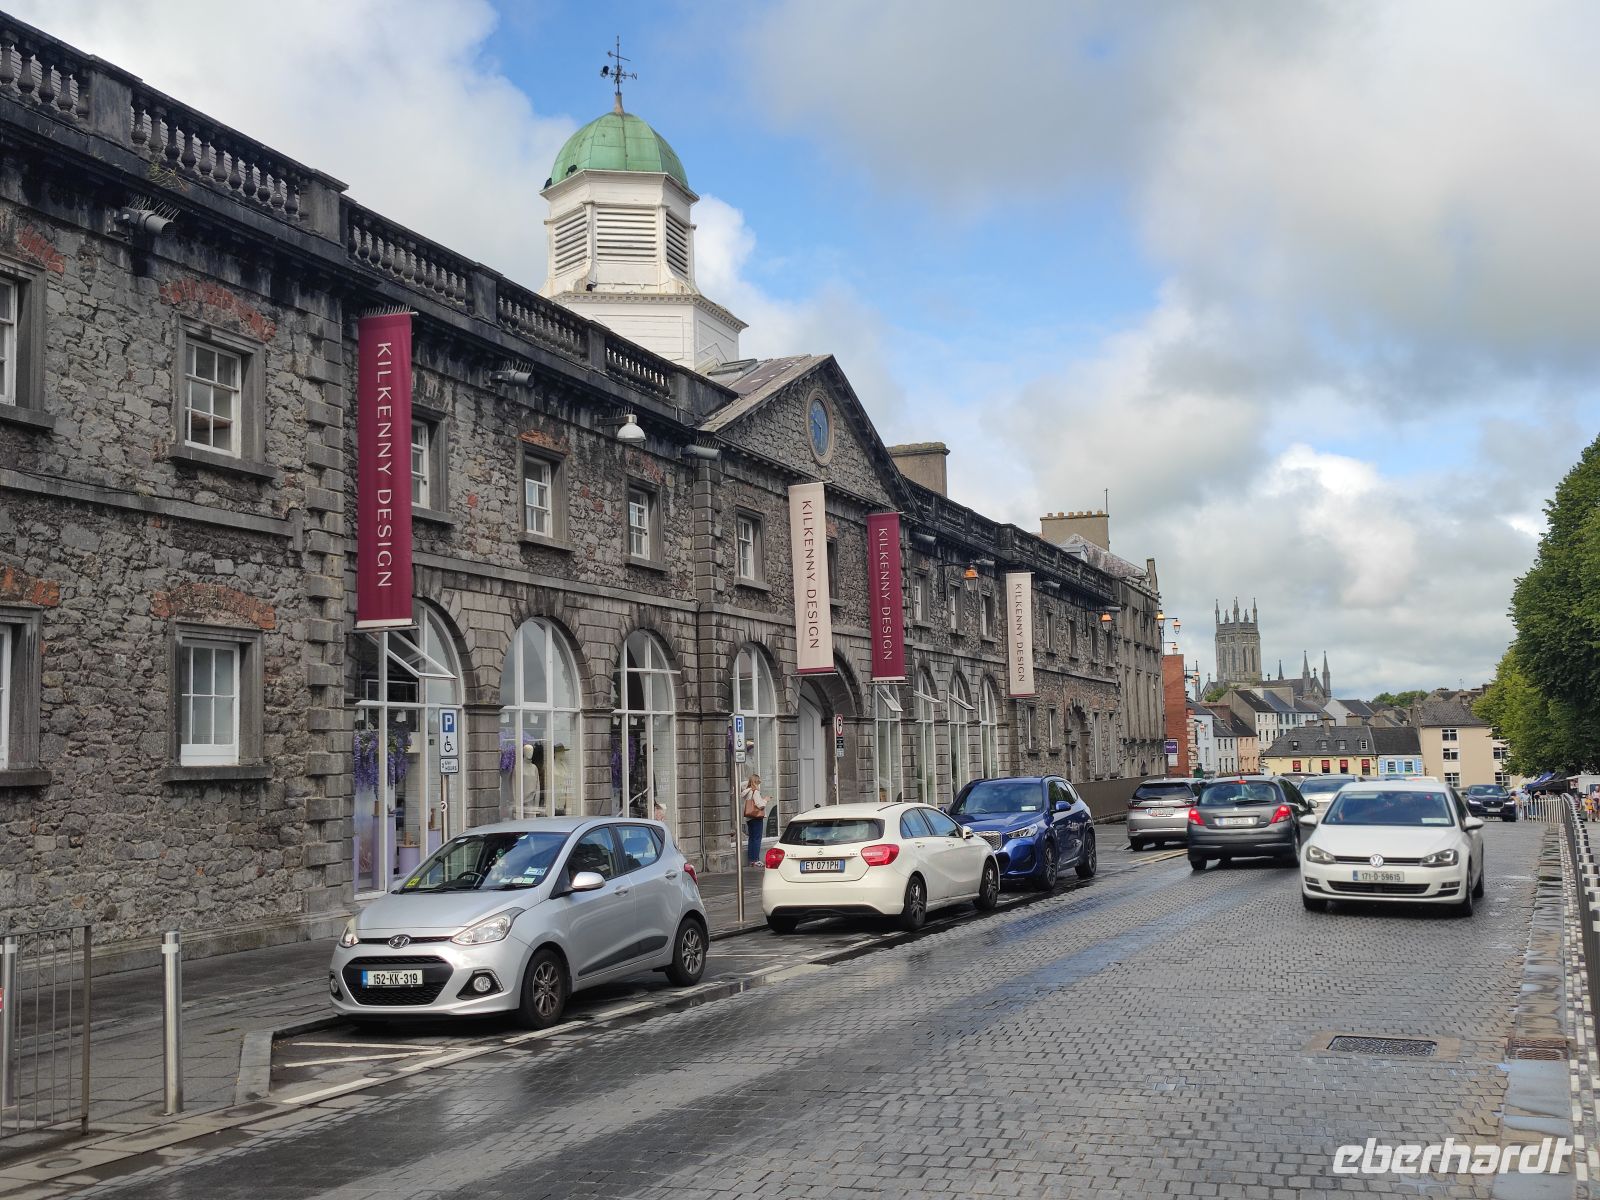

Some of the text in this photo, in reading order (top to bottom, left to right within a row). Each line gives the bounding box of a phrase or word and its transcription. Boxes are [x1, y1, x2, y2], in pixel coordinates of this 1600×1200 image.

[377, 342, 392, 587] KILKENNY DESIGN
[801, 500, 820, 649] KILKENNY DESIGN
[878, 528, 893, 660] KILKENNY DESIGN
[1015, 583, 1025, 682] KILKENNY DESIGN
[444, 714, 453, 731] P
[372, 973, 418, 985] 152-KK-319
